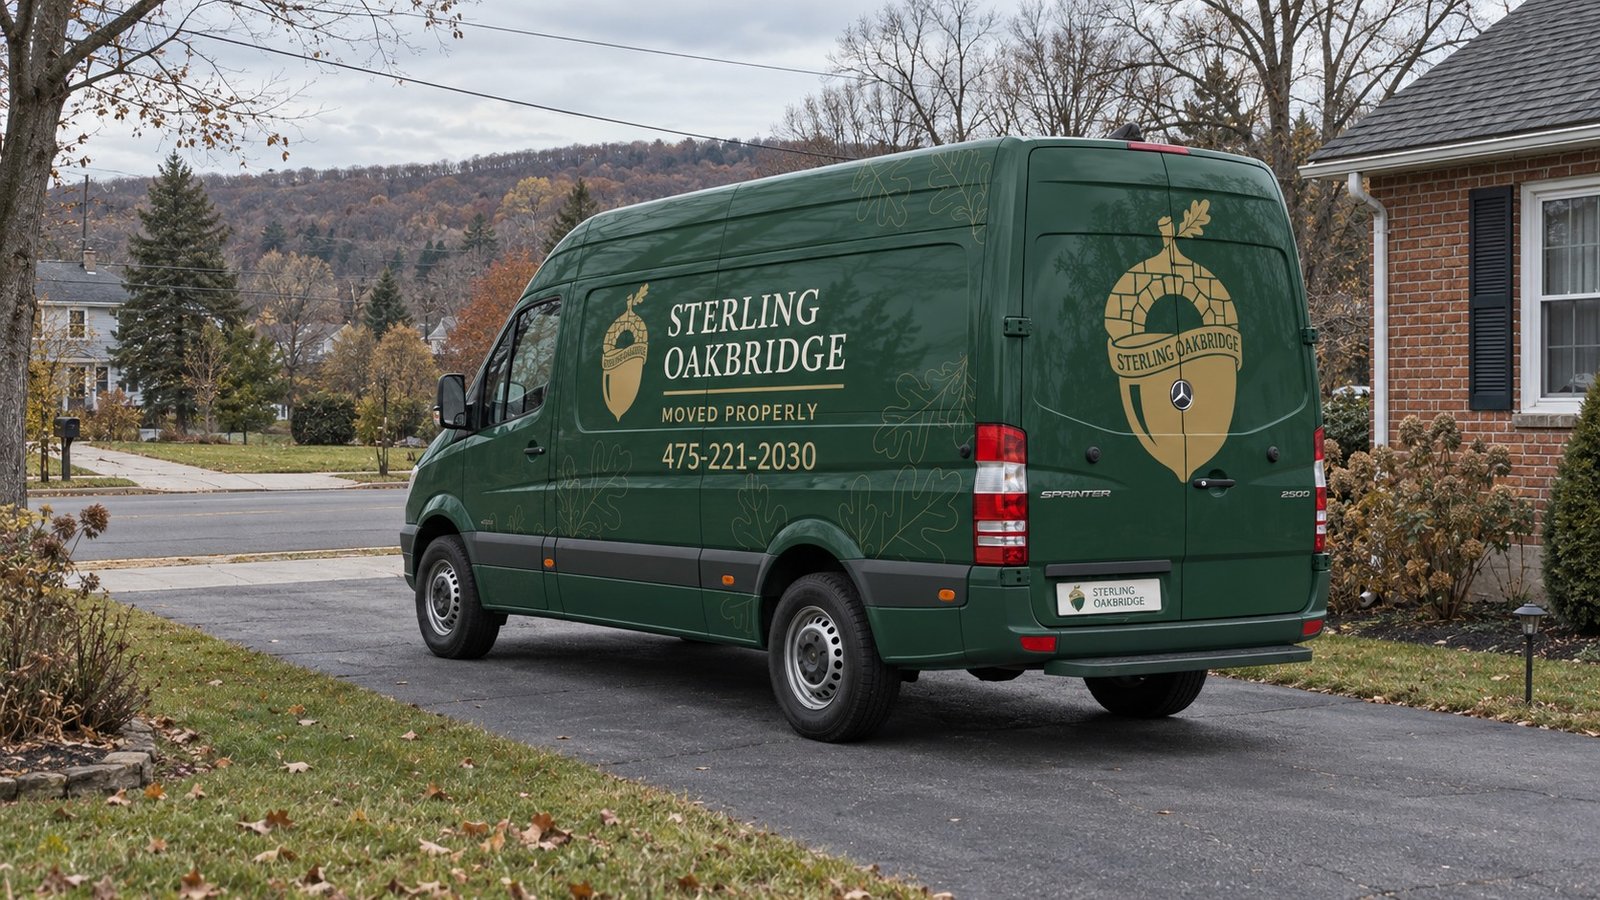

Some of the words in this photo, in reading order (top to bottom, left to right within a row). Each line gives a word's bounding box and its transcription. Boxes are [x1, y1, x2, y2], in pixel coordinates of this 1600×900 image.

[668, 288, 820, 337] STERLING
[664, 333, 847, 380] OAKBRIDGE
[1117, 344, 1175, 371] STERLING
[1176, 331, 1239, 357] OAKBRIDGE
[661, 406, 718, 423] MOVED
[725, 403, 818, 421] PROPERLY
[662, 441, 817, 471] 475-221-2030
[1040, 489, 1111, 499] SPRINTER
[1280, 490, 1310, 498] 2500
[1092, 586, 1136, 598] STERLING
[1093, 596, 1145, 608] OAKBRIDGE
